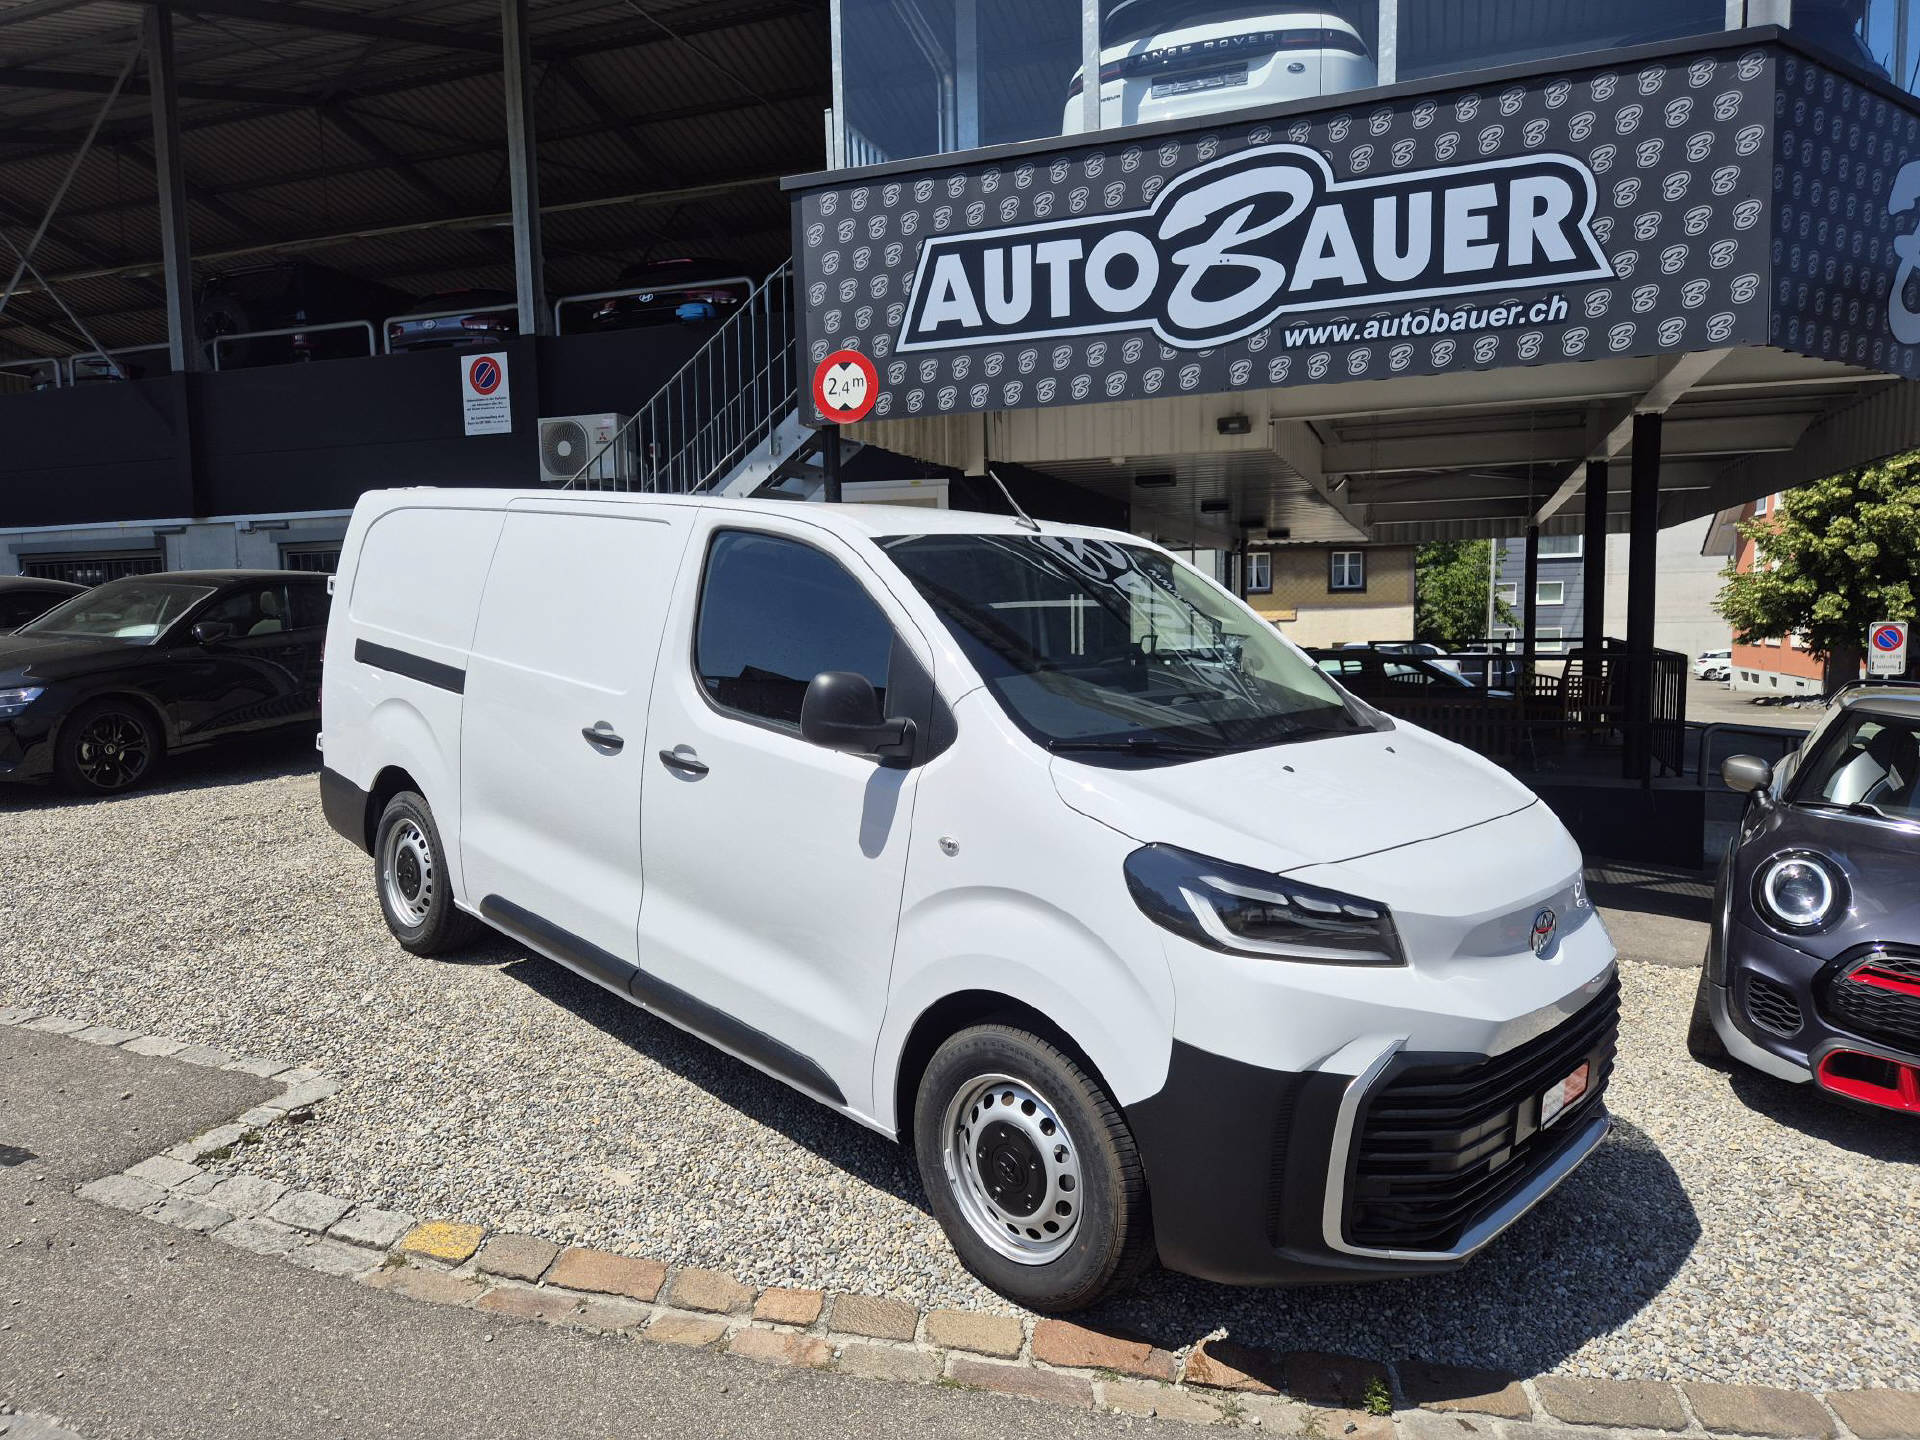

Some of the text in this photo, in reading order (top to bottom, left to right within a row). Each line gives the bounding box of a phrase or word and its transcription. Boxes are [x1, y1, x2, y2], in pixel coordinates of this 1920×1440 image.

[1127, 33, 1274, 67] ANGE ROVER
[918, 165, 1577, 332] AUTO BAUER
[1284, 295, 1569, 348] www.autobauer.ch
